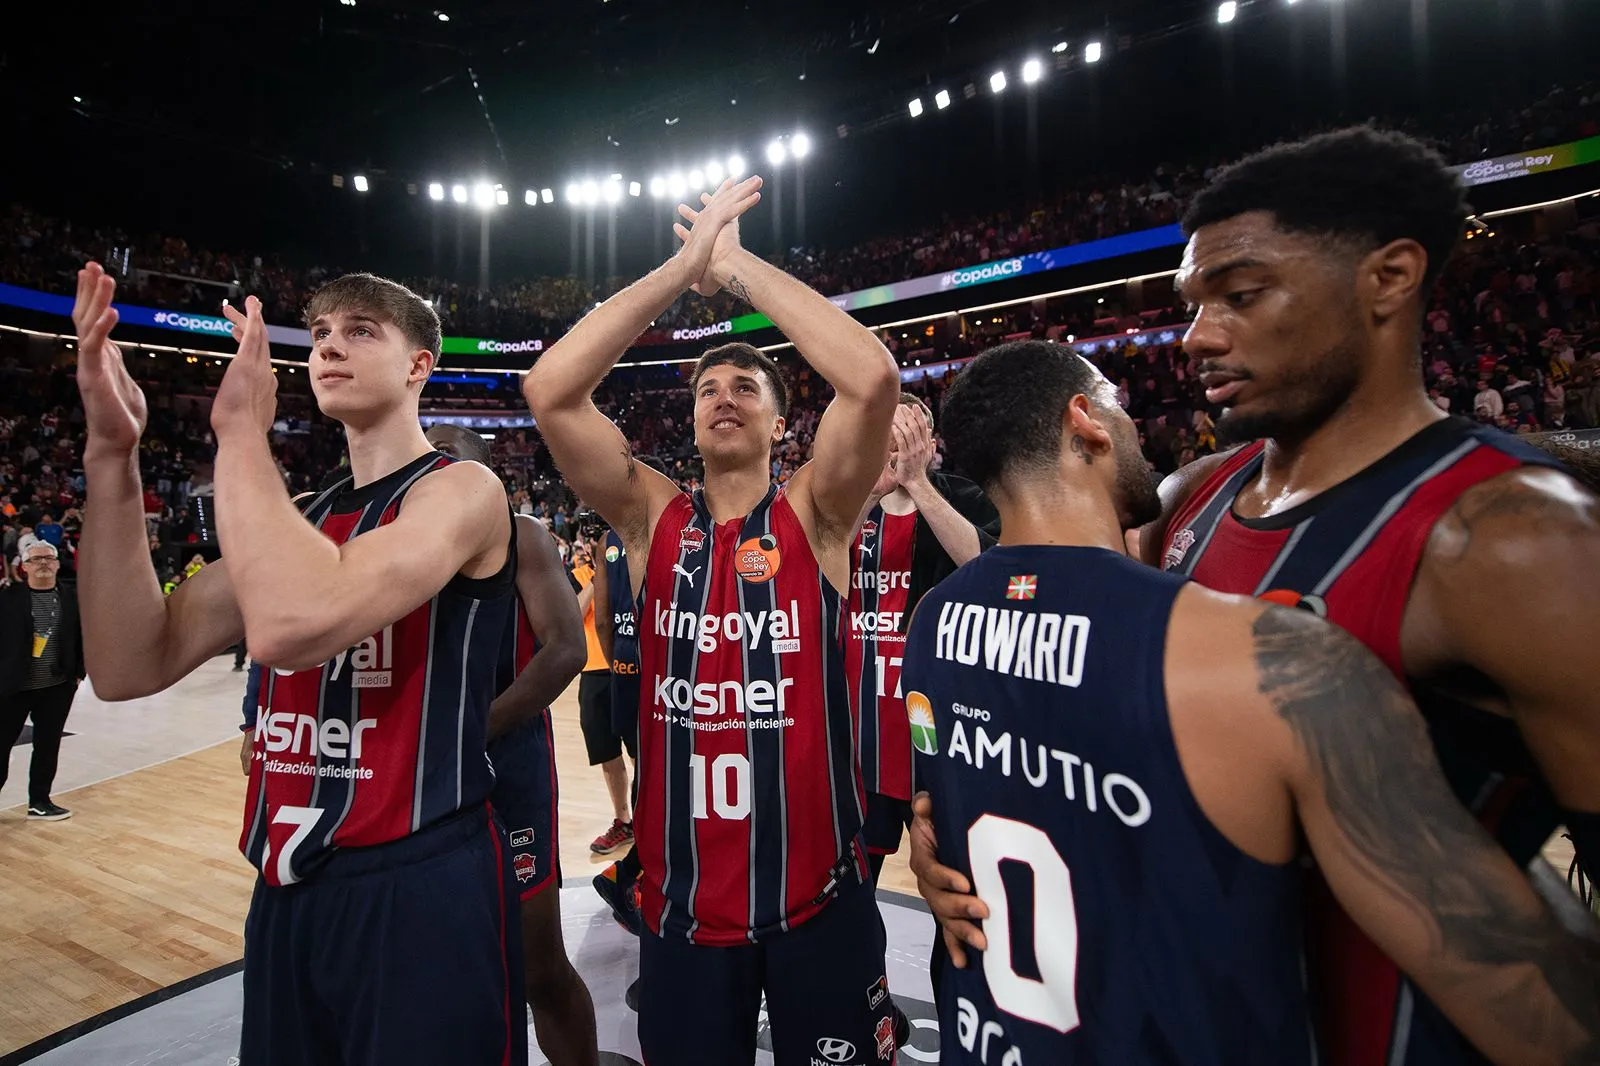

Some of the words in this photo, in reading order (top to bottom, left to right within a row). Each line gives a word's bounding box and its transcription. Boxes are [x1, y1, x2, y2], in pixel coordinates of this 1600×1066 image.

[1463, 163, 1505, 178] Copa
[1525, 154, 1554, 167] Rey
[941, 259, 1023, 286] #CopaACB
[154, 312, 235, 333] #CopaAC
[672, 321, 733, 340] #CopaACB
[477, 340, 543, 353] #CopaACB
[742, 555, 766, 564] Copa
[869, 634, 907, 643] Climatizació
[935, 601, 1092, 688] HOWARD
[952, 702, 991, 722] GRUPO
[680, 716, 746, 732] Climatización
[748, 716, 795, 729] eficiente
[265, 760, 316, 776] atización
[318, 764, 374, 780] eficiente
[948, 720, 1152, 828] AMUTIO
[689, 753, 751, 820] 10
[262, 804, 325, 887] 7
[512, 835, 529, 845] acb
[967, 813, 1080, 1034] 0
[871, 988, 884, 1005] acb
